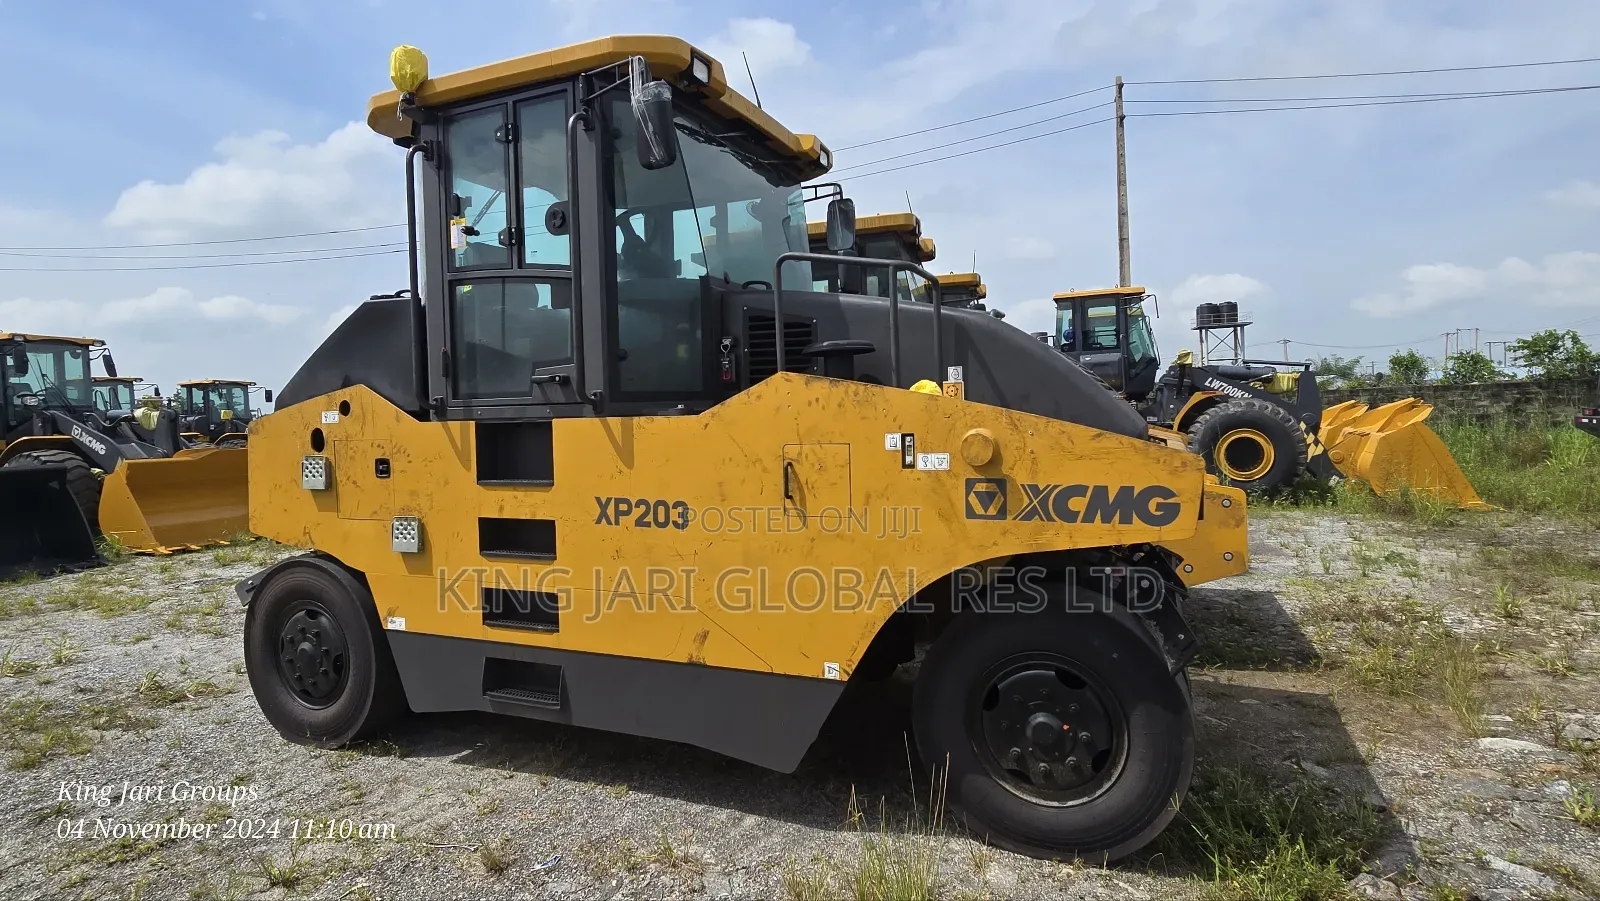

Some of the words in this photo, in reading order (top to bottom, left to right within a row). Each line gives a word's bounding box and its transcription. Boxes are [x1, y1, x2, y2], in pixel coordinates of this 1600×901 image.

[80, 431, 106, 455] XCMG
[594, 496, 690, 530] XP203
[1012, 484, 1181, 527] XCMG
